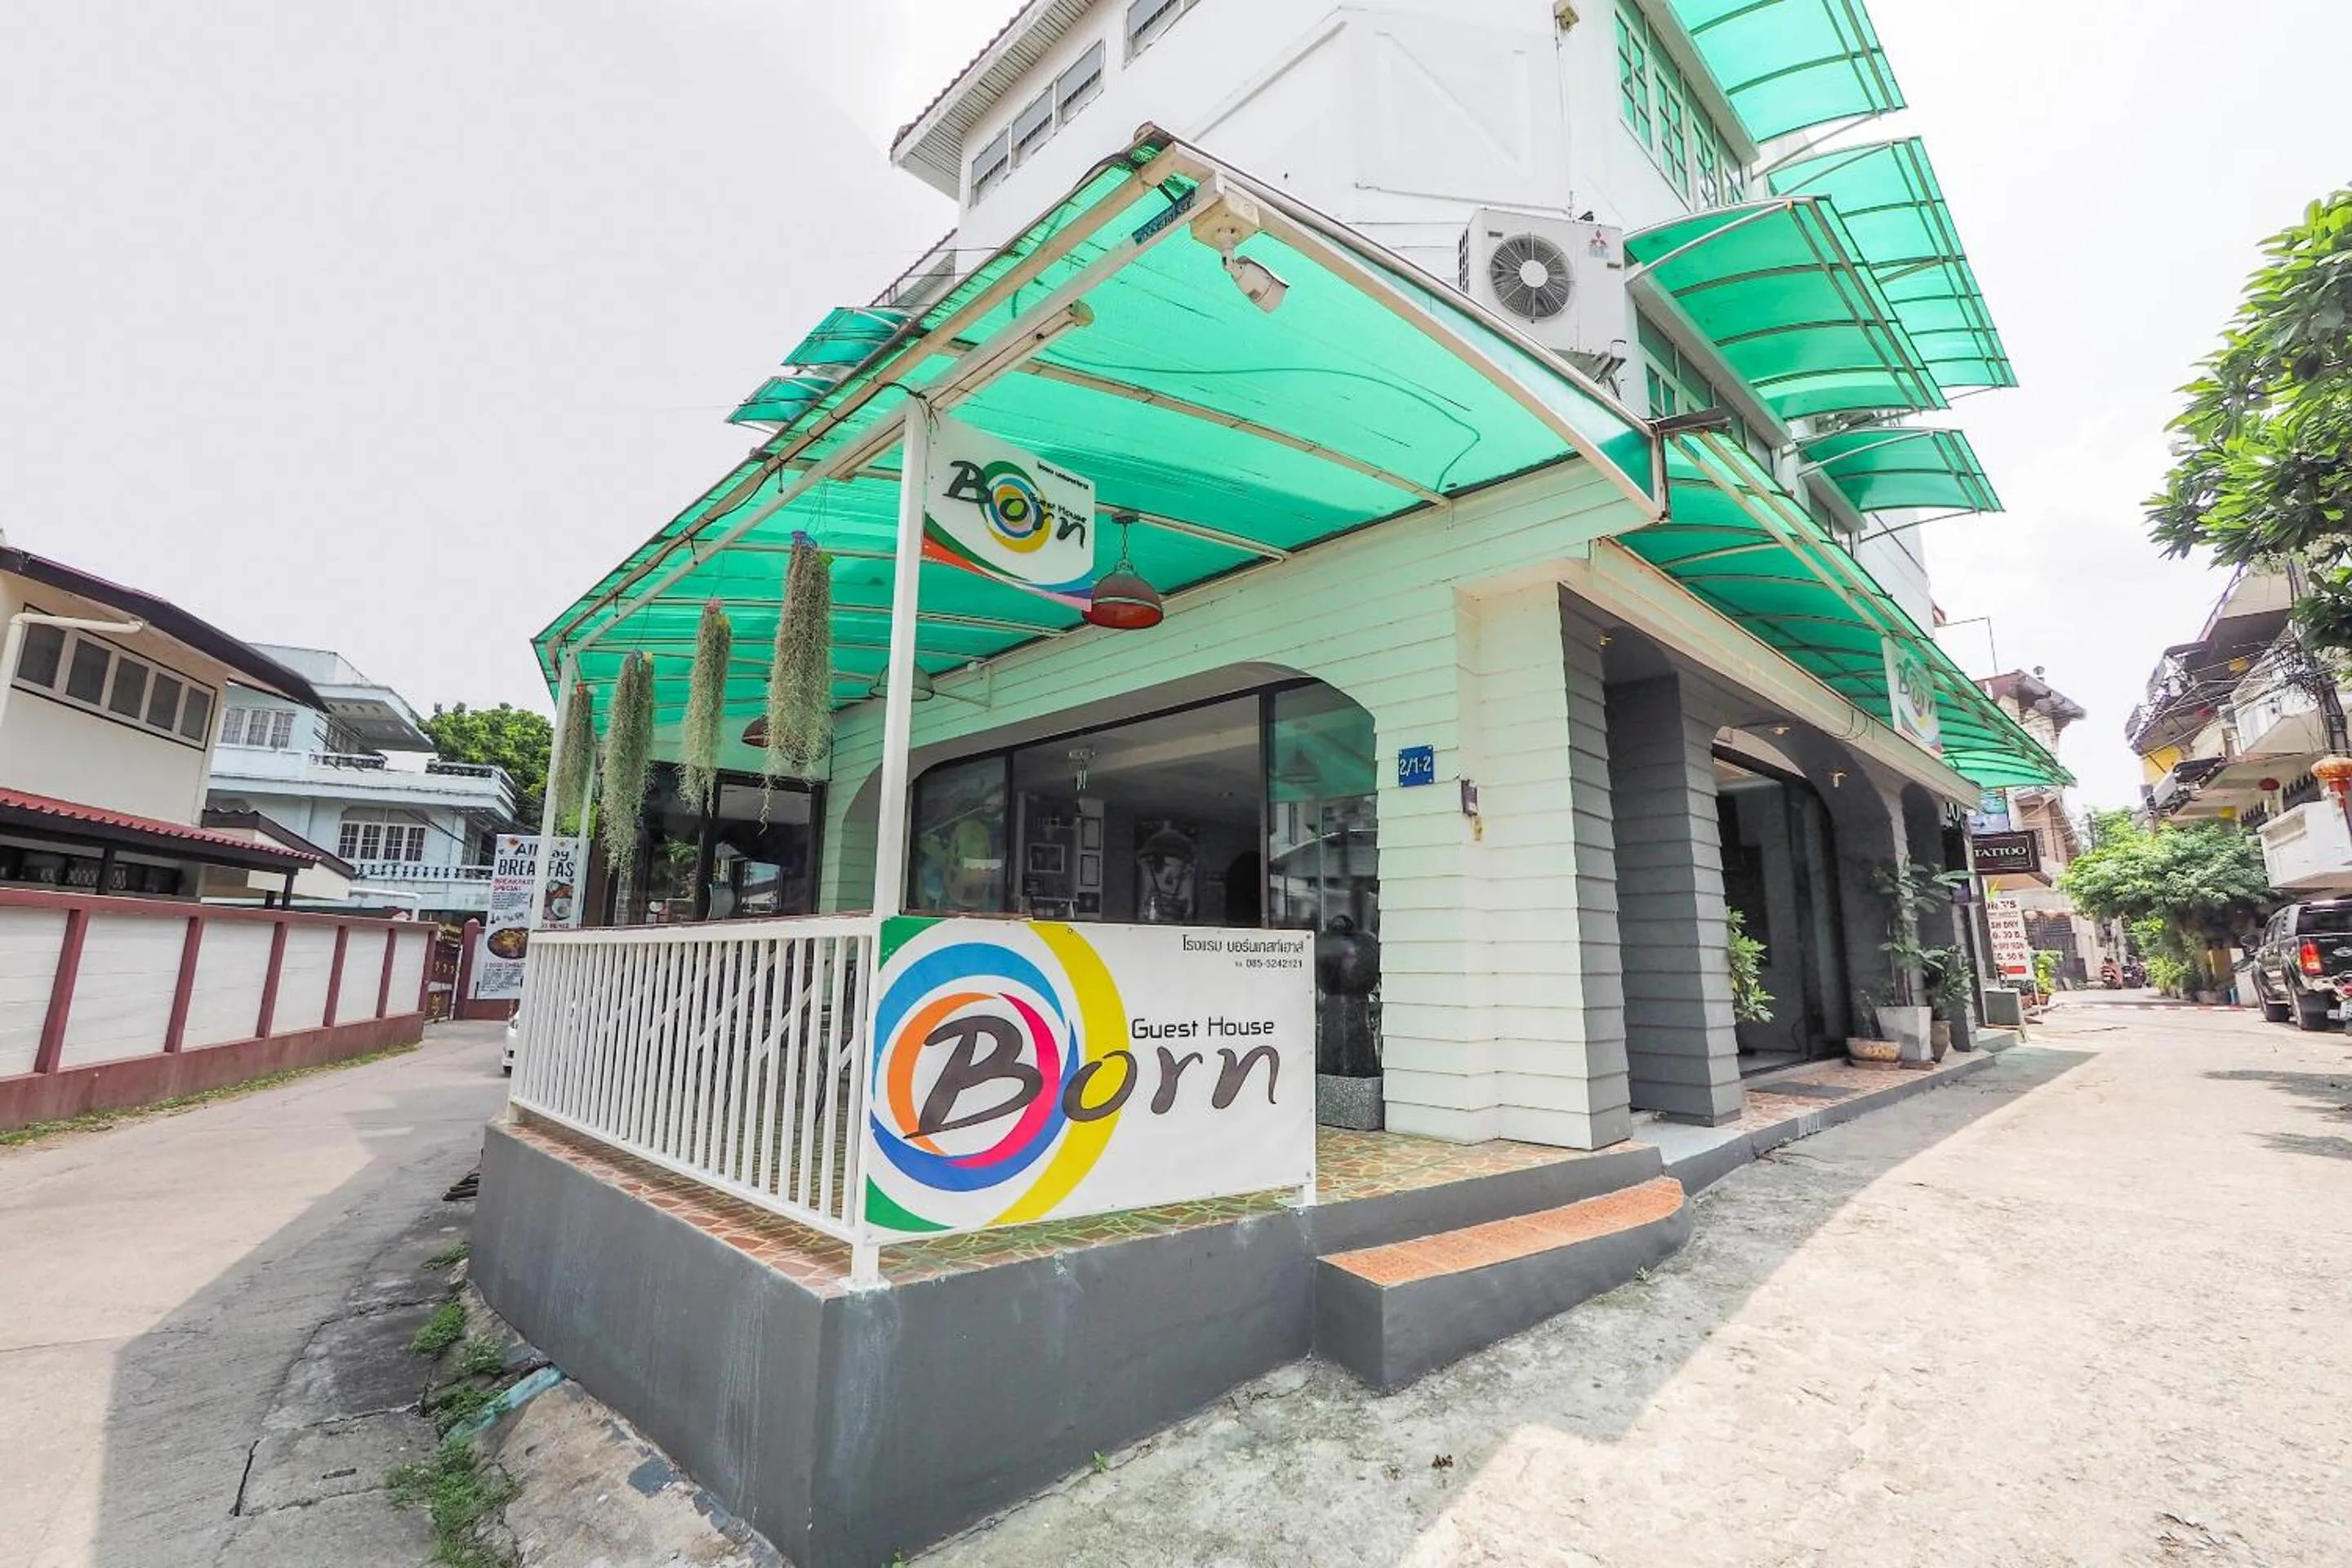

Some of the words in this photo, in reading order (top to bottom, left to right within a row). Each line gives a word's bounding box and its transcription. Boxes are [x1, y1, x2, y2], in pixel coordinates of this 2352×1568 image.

[942, 461, 1086, 550] Born
[1058, 503, 1088, 523] House
[1399, 755, 1432, 777] 2/1-2
[1974, 845, 2027, 858] TATTOO
[497, 858, 575, 878] BREAFAS
[1132, 1018, 1199, 1040] Guest
[1208, 1015, 1275, 1036] House
[902, 1014, 1281, 1139] Born
